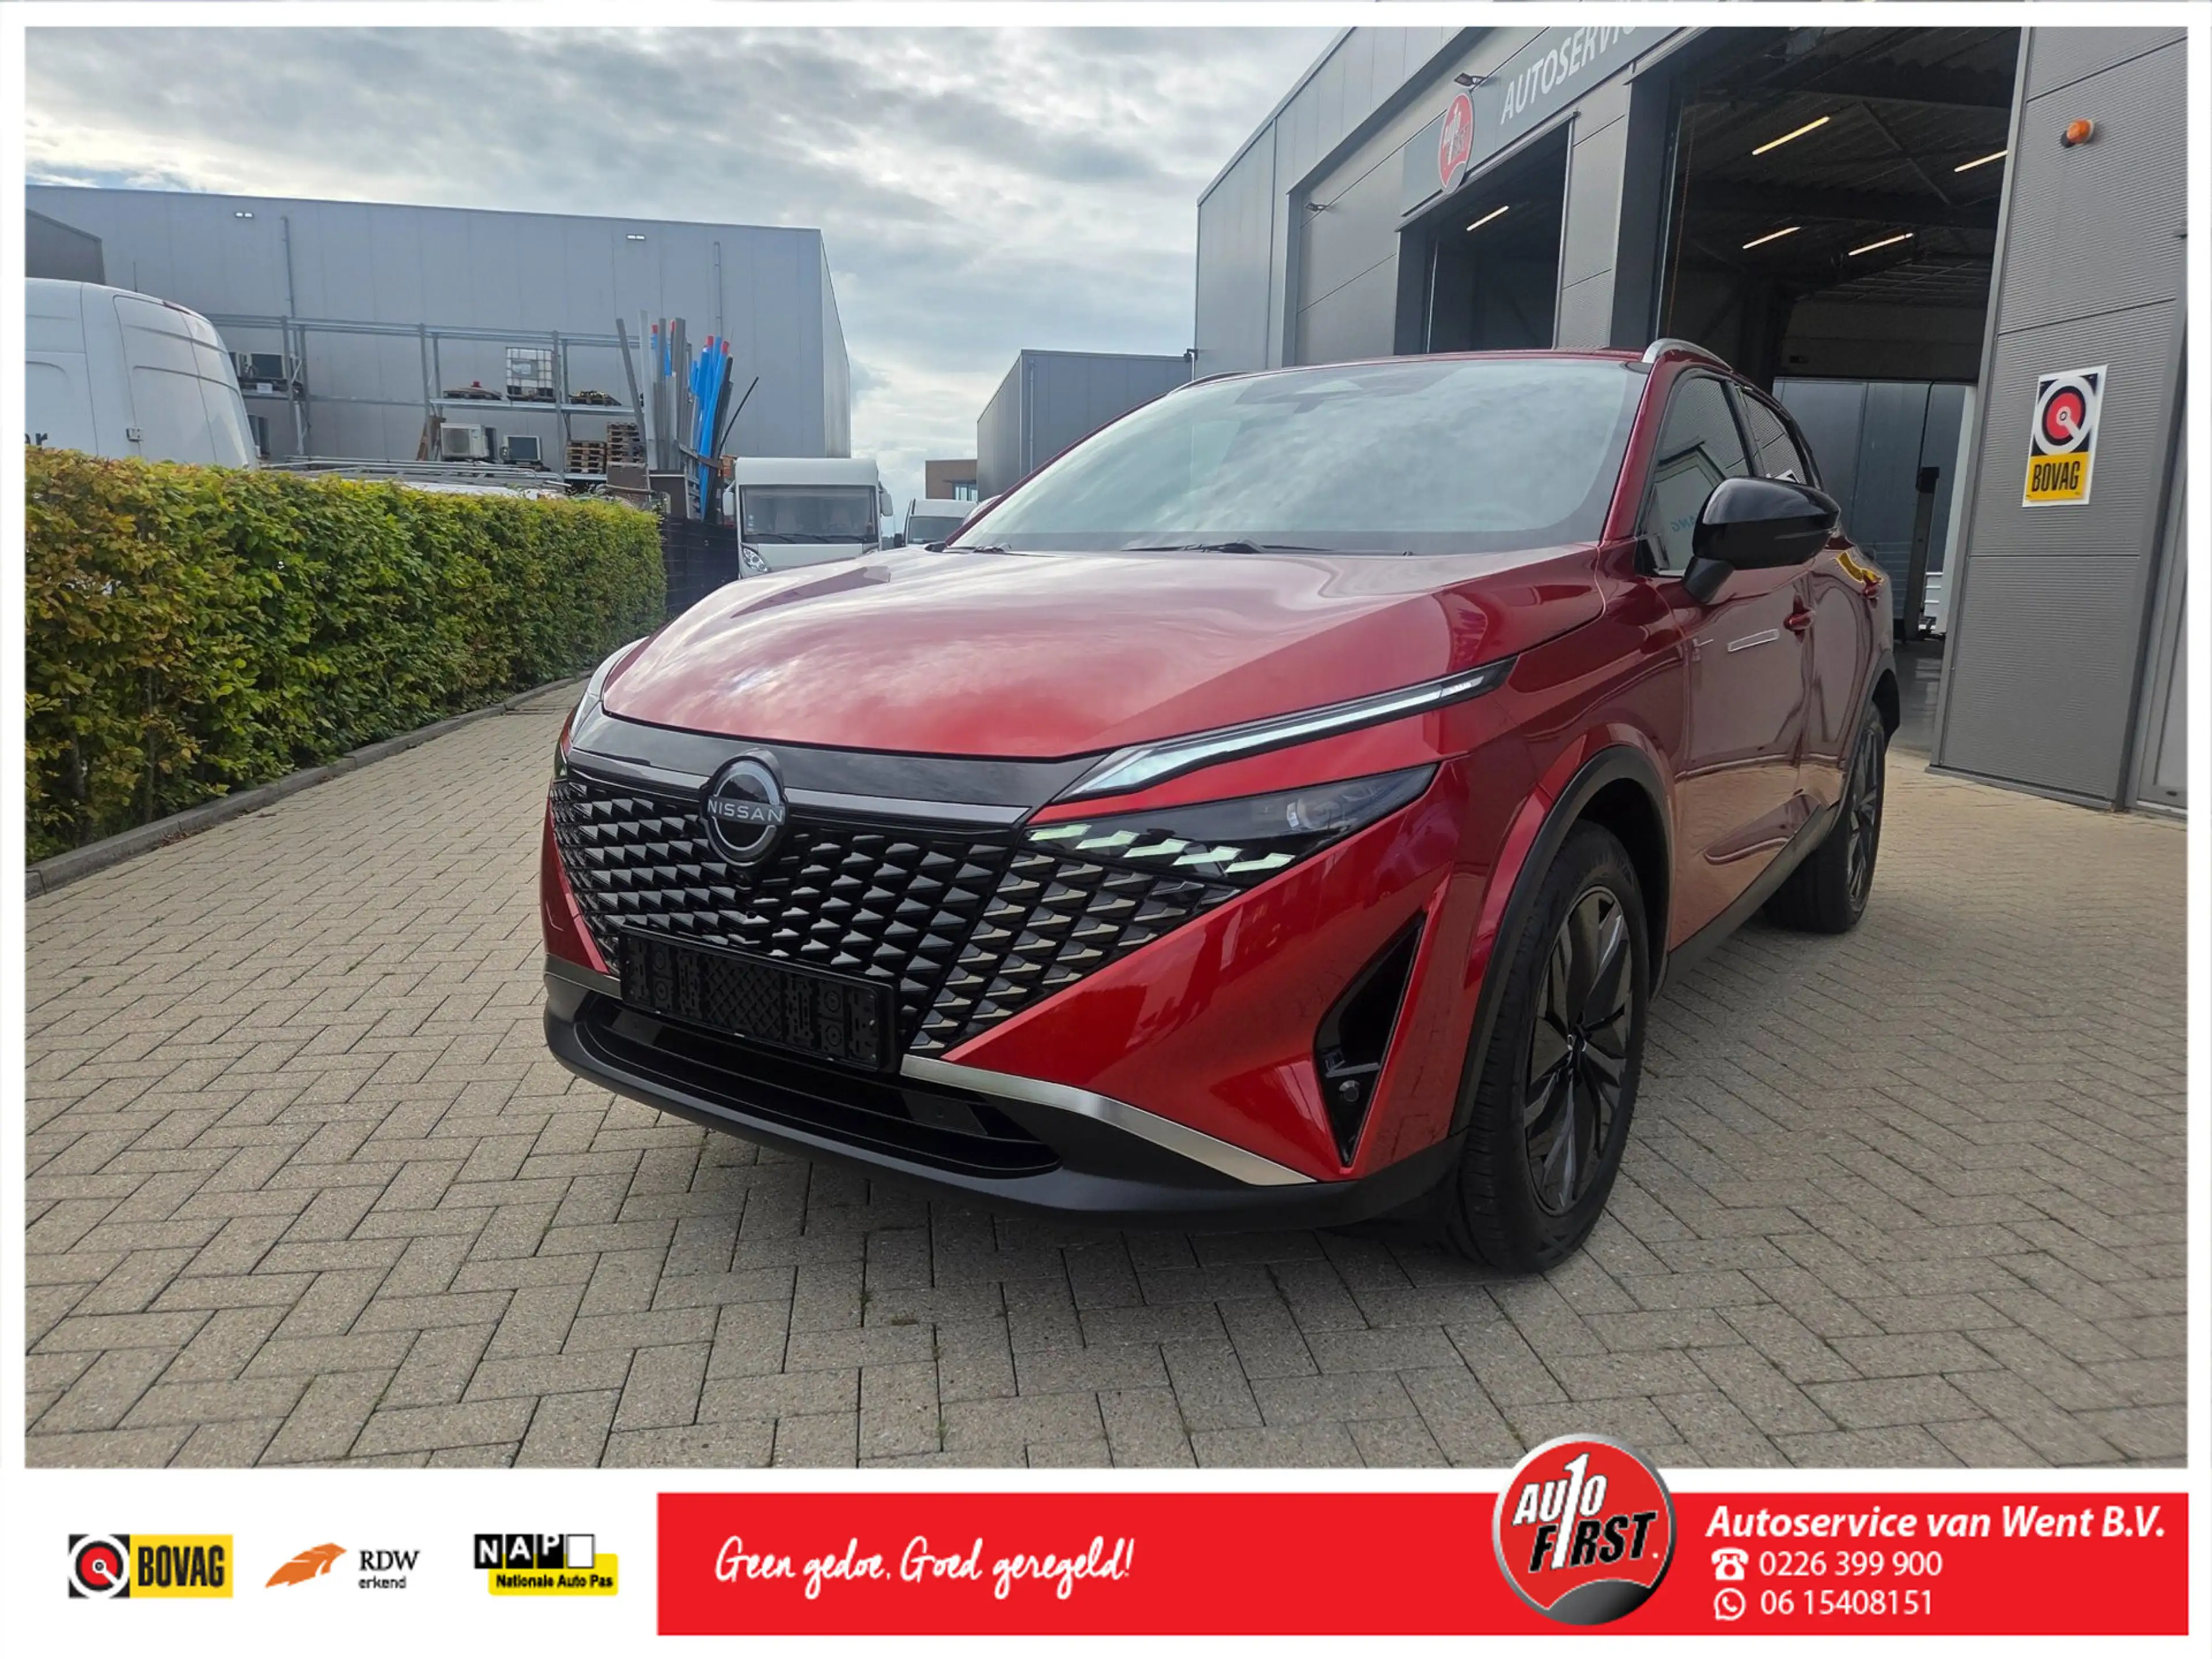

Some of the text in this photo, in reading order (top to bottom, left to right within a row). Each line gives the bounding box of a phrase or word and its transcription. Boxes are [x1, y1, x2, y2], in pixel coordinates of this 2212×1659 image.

[1500, 26, 1635, 125] AUTOSERV
[2032, 461, 2081, 492] BOVAG
[707, 798, 783, 823] NISSAN
